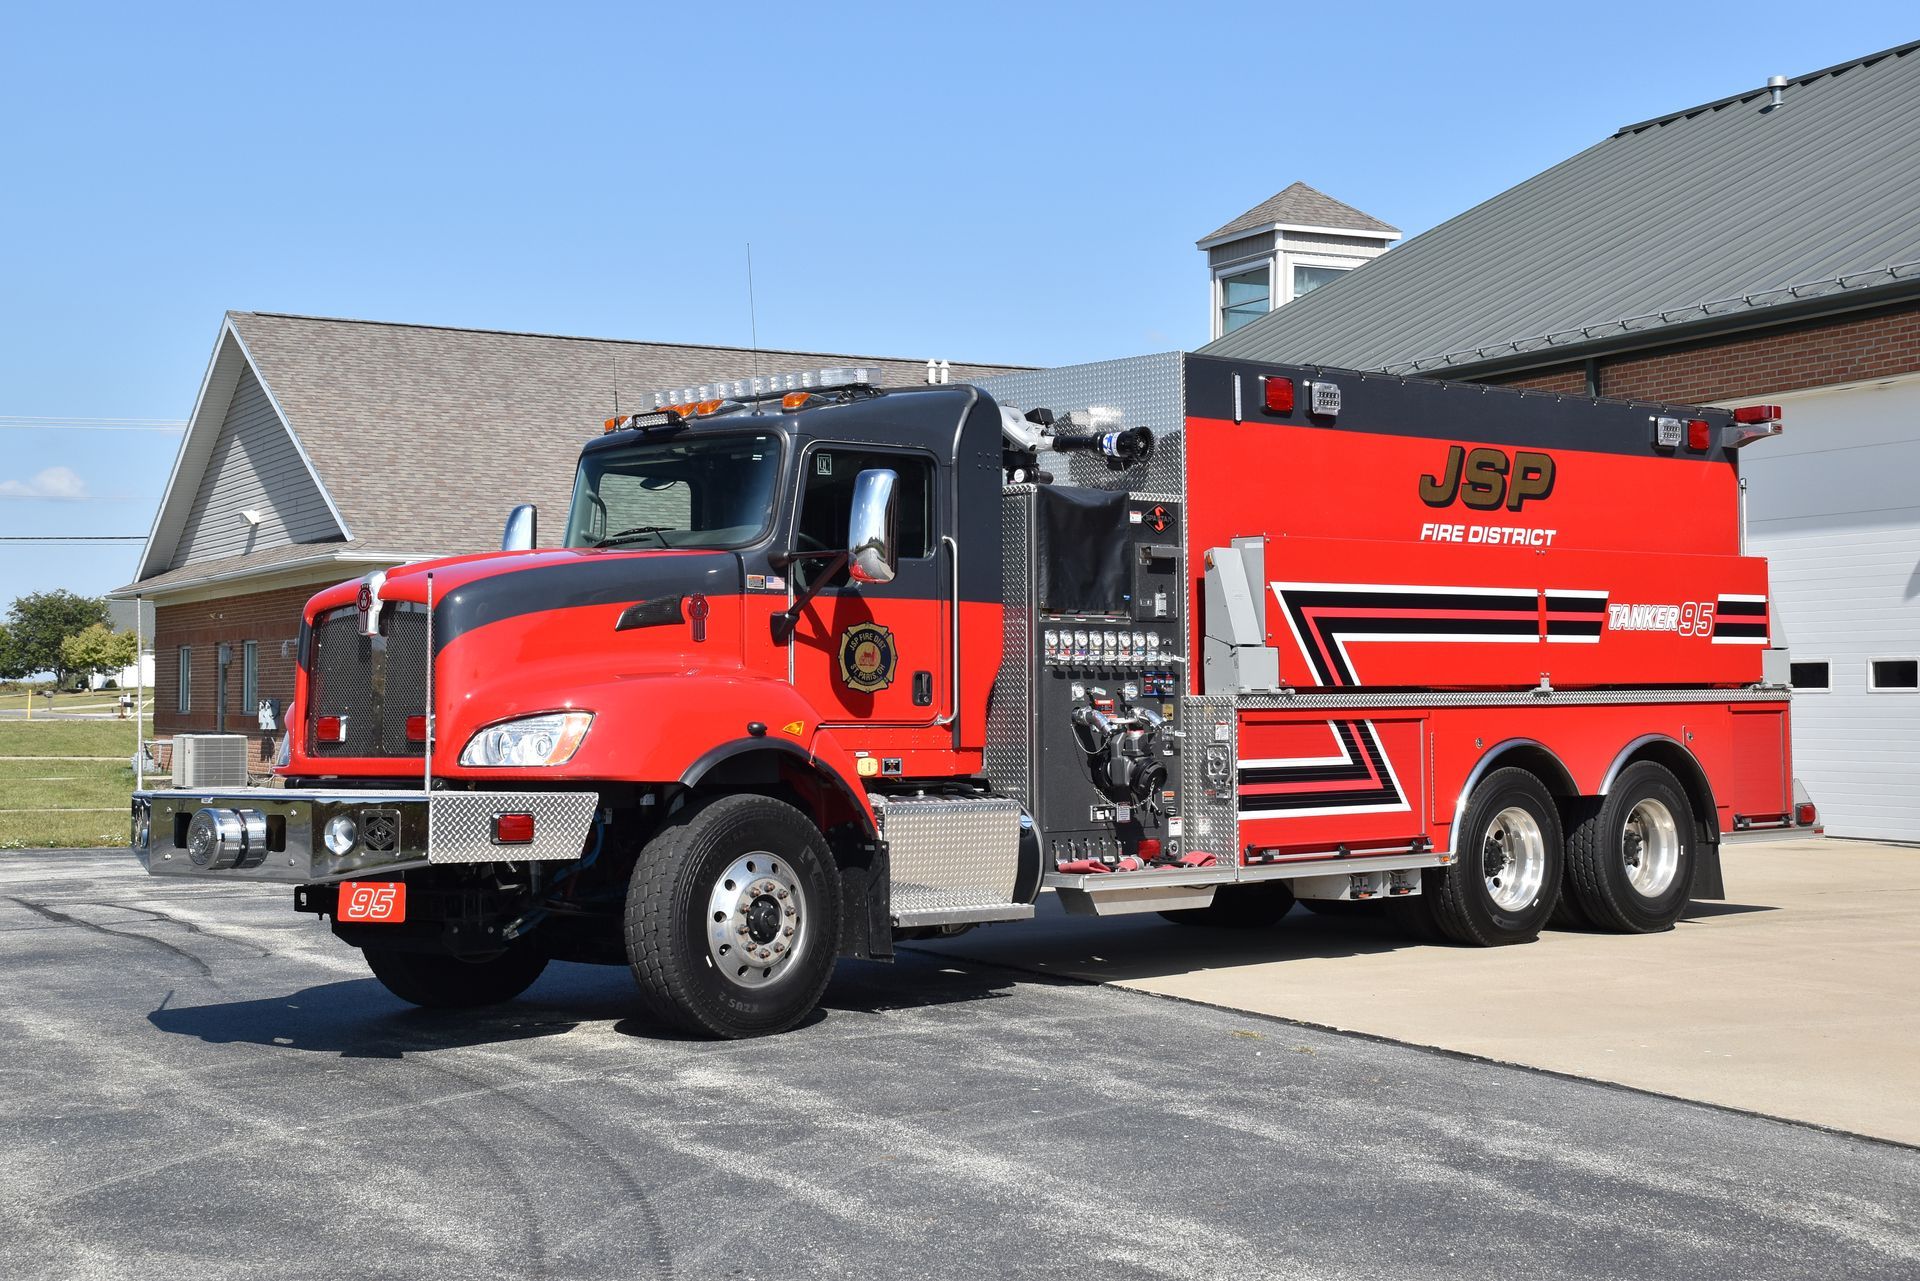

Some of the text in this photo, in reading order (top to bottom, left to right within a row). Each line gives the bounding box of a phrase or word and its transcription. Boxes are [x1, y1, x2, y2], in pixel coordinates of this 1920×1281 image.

[1418, 445, 1556, 512] JSP
[1420, 523, 1557, 546] FIRE DISTRICT
[1608, 602, 1714, 636] TANKER 95
[849, 638, 858, 650] JSP
[859, 633, 873, 641] FIRE
[877, 664, 886, 675] OH
[348, 887, 396, 918] 95
